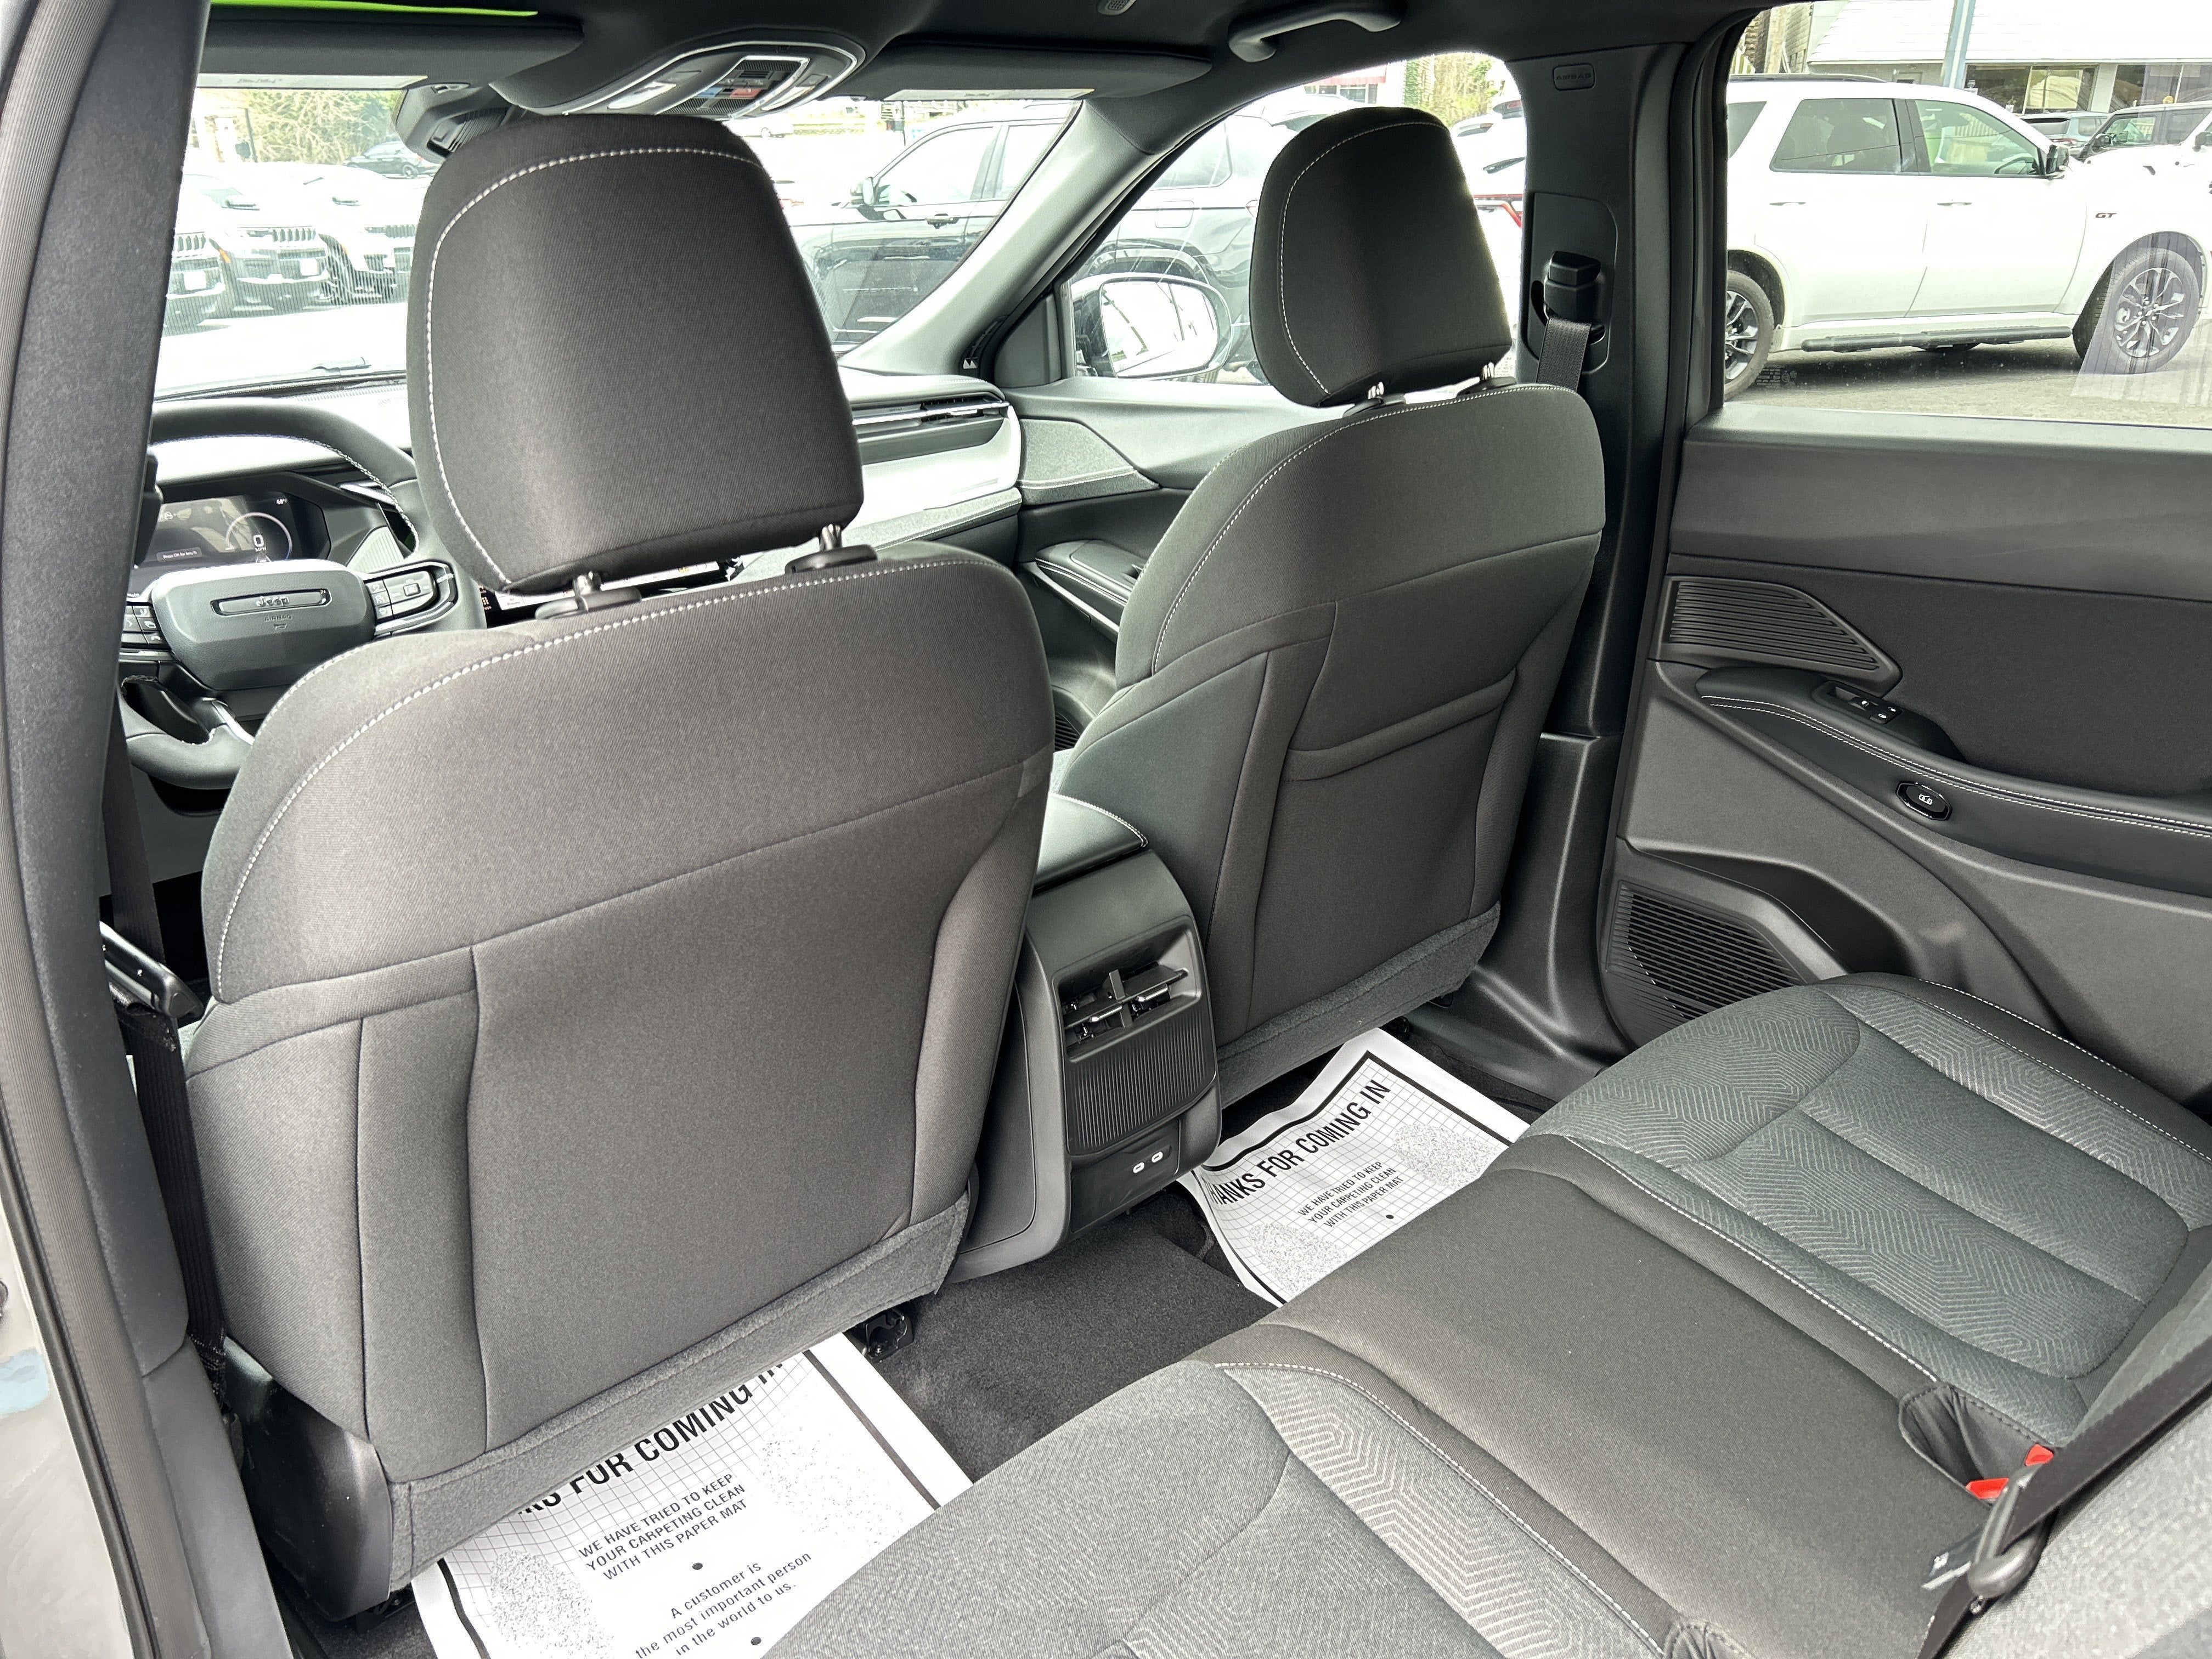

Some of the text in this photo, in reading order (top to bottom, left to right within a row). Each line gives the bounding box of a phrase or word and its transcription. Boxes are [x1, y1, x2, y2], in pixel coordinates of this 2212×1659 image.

[253, 534, 264, 547] 0
[256, 596, 289, 607] Jeep
[264, 614, 293, 623] AIRBAG
[1257, 1149, 1304, 1178] FOR
[1295, 1102, 1372, 1153] COMING
[1360, 1080, 1391, 1104] IN
[1297, 1161, 1383, 1216] WE HAVE TRIED TO KEEP
[1308, 1167, 1397, 1223] YOUR CARPETING CLEAN
[1324, 1176, 1404, 1227] WITH THIS PAPER MAT
[634, 1384, 753, 1462] COMING
[579, 1474, 733, 1558] WE HAVE TRIED TO KEEP
[586, 1484, 745, 1571] YOUR CARPETING CLEAN
[603, 1499, 748, 1580] WITH THIS PAPER MAT
[635, 1553, 812, 1658] the most important person
[671, 1562, 761, 1618] A customer is
[674, 1582, 797, 1656] in the world to us.
